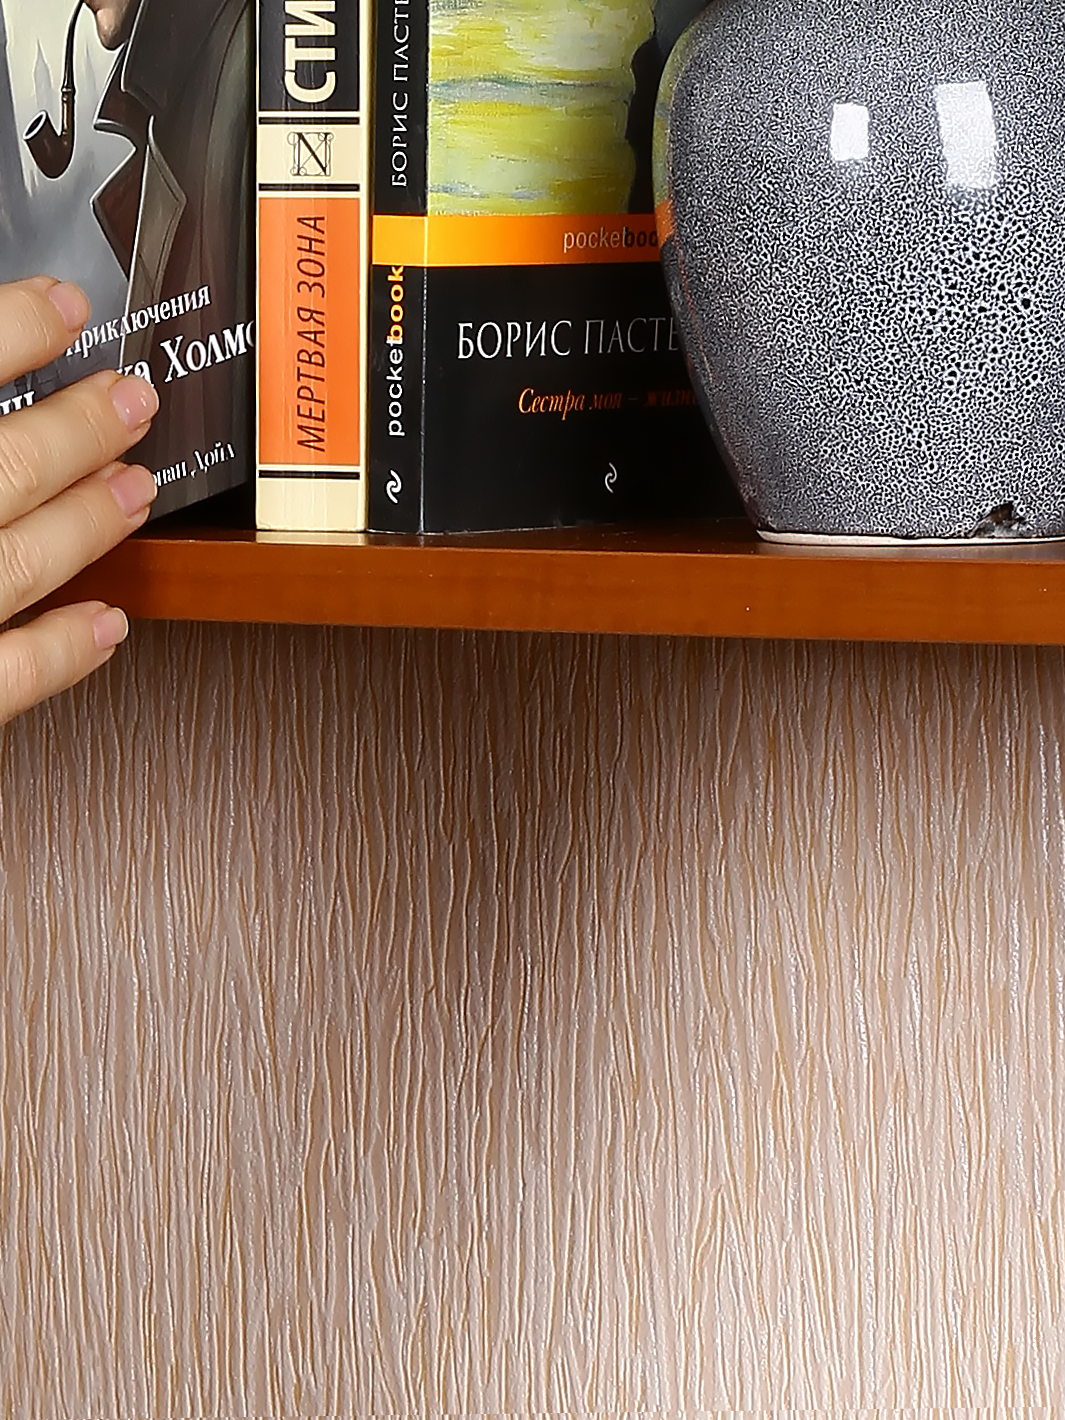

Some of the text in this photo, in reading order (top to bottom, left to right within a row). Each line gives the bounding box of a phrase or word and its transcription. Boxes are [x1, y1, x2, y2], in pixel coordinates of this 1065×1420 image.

[391, 94, 409, 188] БОРИС
[563, 226, 659, 253] pocketboo
[297, 214, 327, 454] МЕРТВАЯ ЗОНА
[457, 317, 679, 359] БОРИС ПАСТЕ
[518, 387, 585, 421] Сестра
[589, 391, 623, 410] моя
[643, 389, 698, 409] жизн
